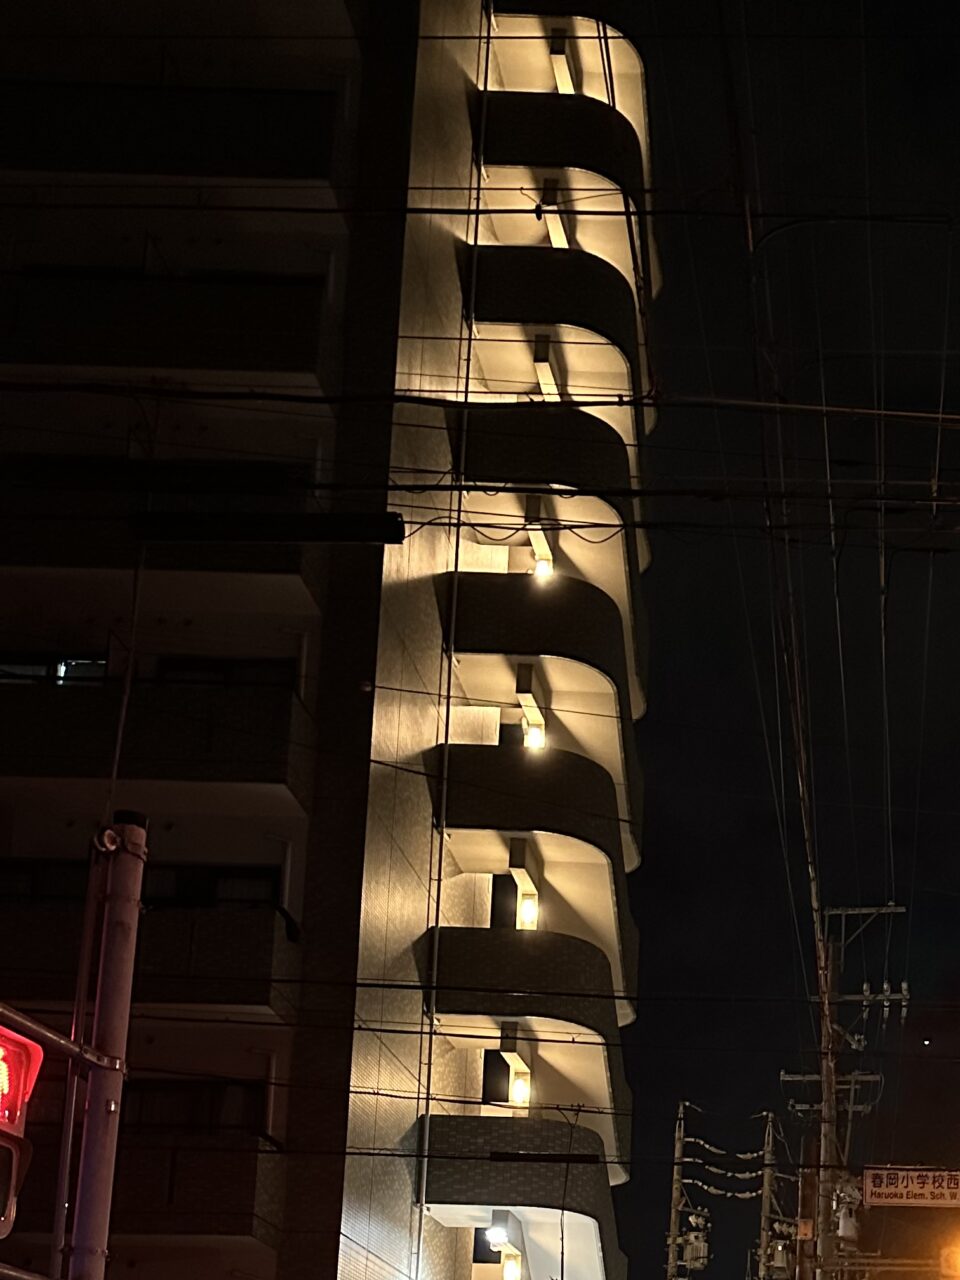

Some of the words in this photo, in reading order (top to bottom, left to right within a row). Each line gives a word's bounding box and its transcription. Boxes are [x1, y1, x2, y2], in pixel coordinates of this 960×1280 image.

[871, 1172, 960, 1189] 春岡小学校西
[870, 1189, 904, 1200] Haruoka
[906, 1190, 928, 1200] Elem.
